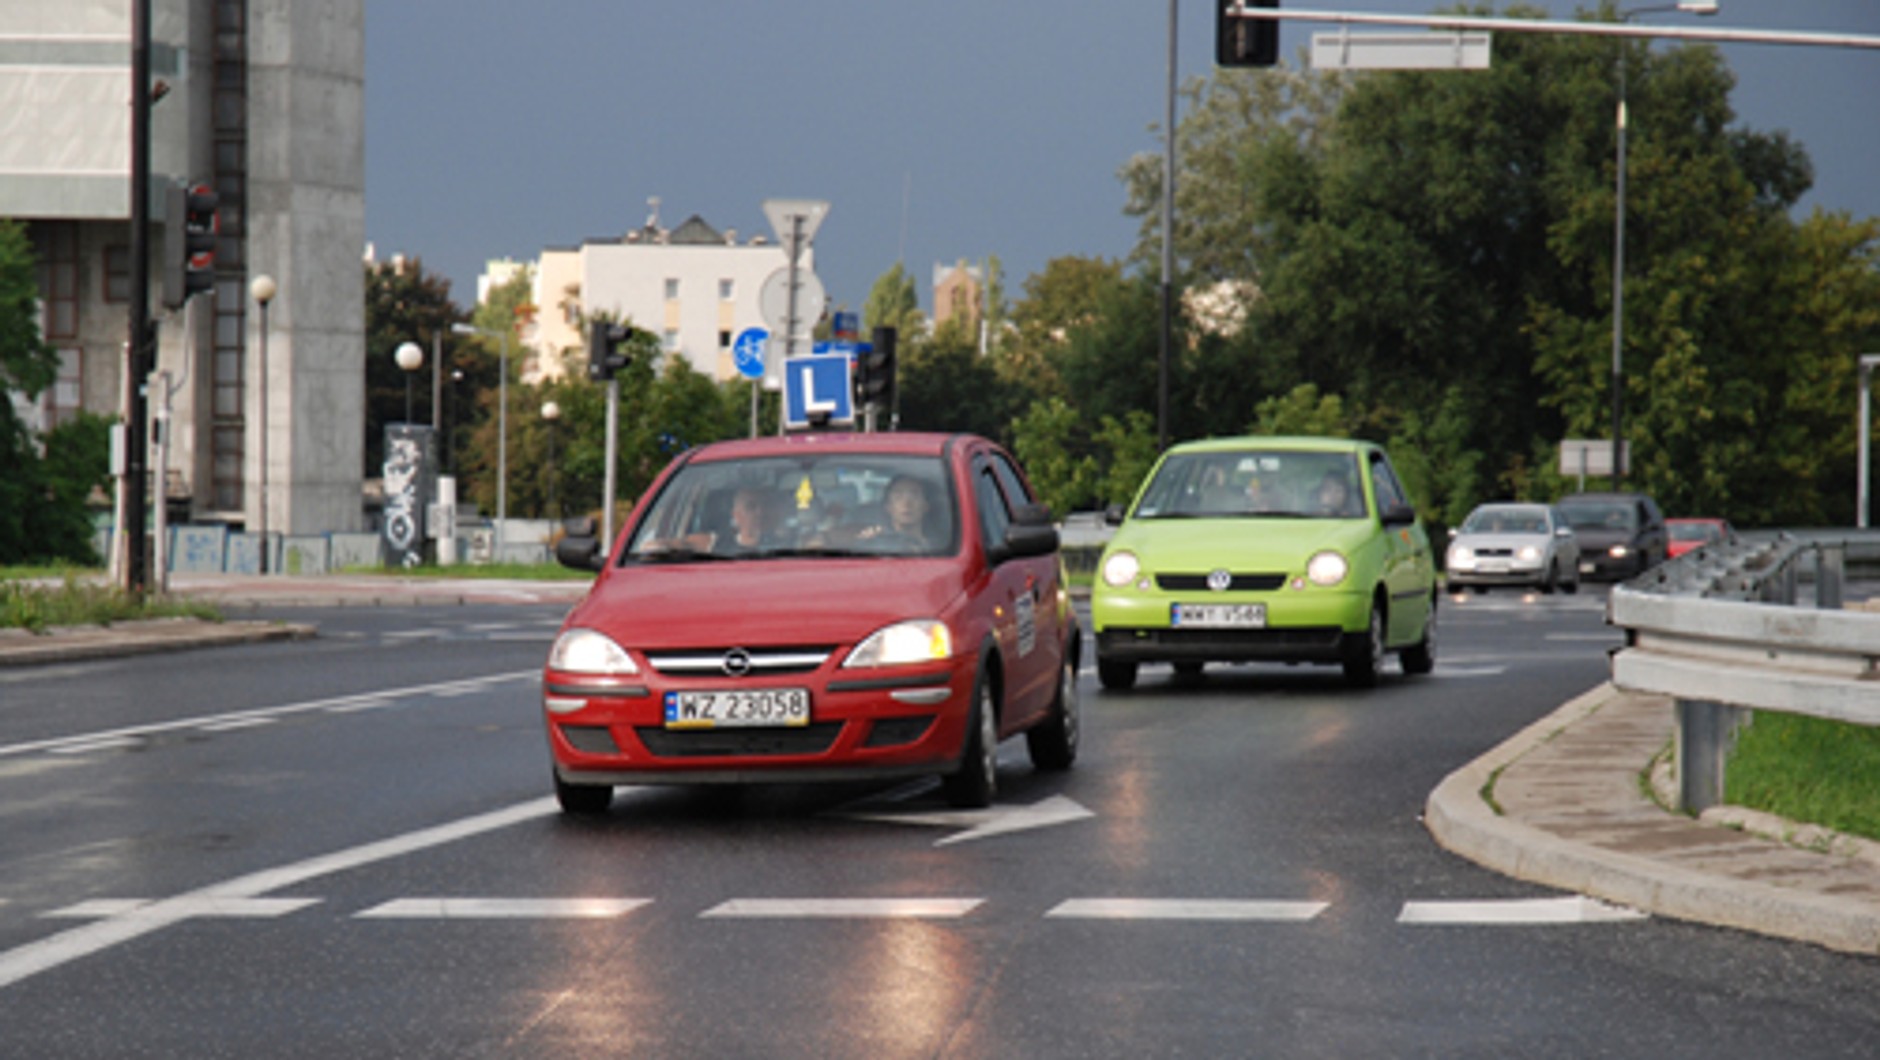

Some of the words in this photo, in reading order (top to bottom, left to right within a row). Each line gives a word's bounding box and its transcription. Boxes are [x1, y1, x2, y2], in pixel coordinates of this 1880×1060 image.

[801, 367, 837, 413] L
[680, 694, 716, 719] WZ
[725, 692, 803, 719] 23058
